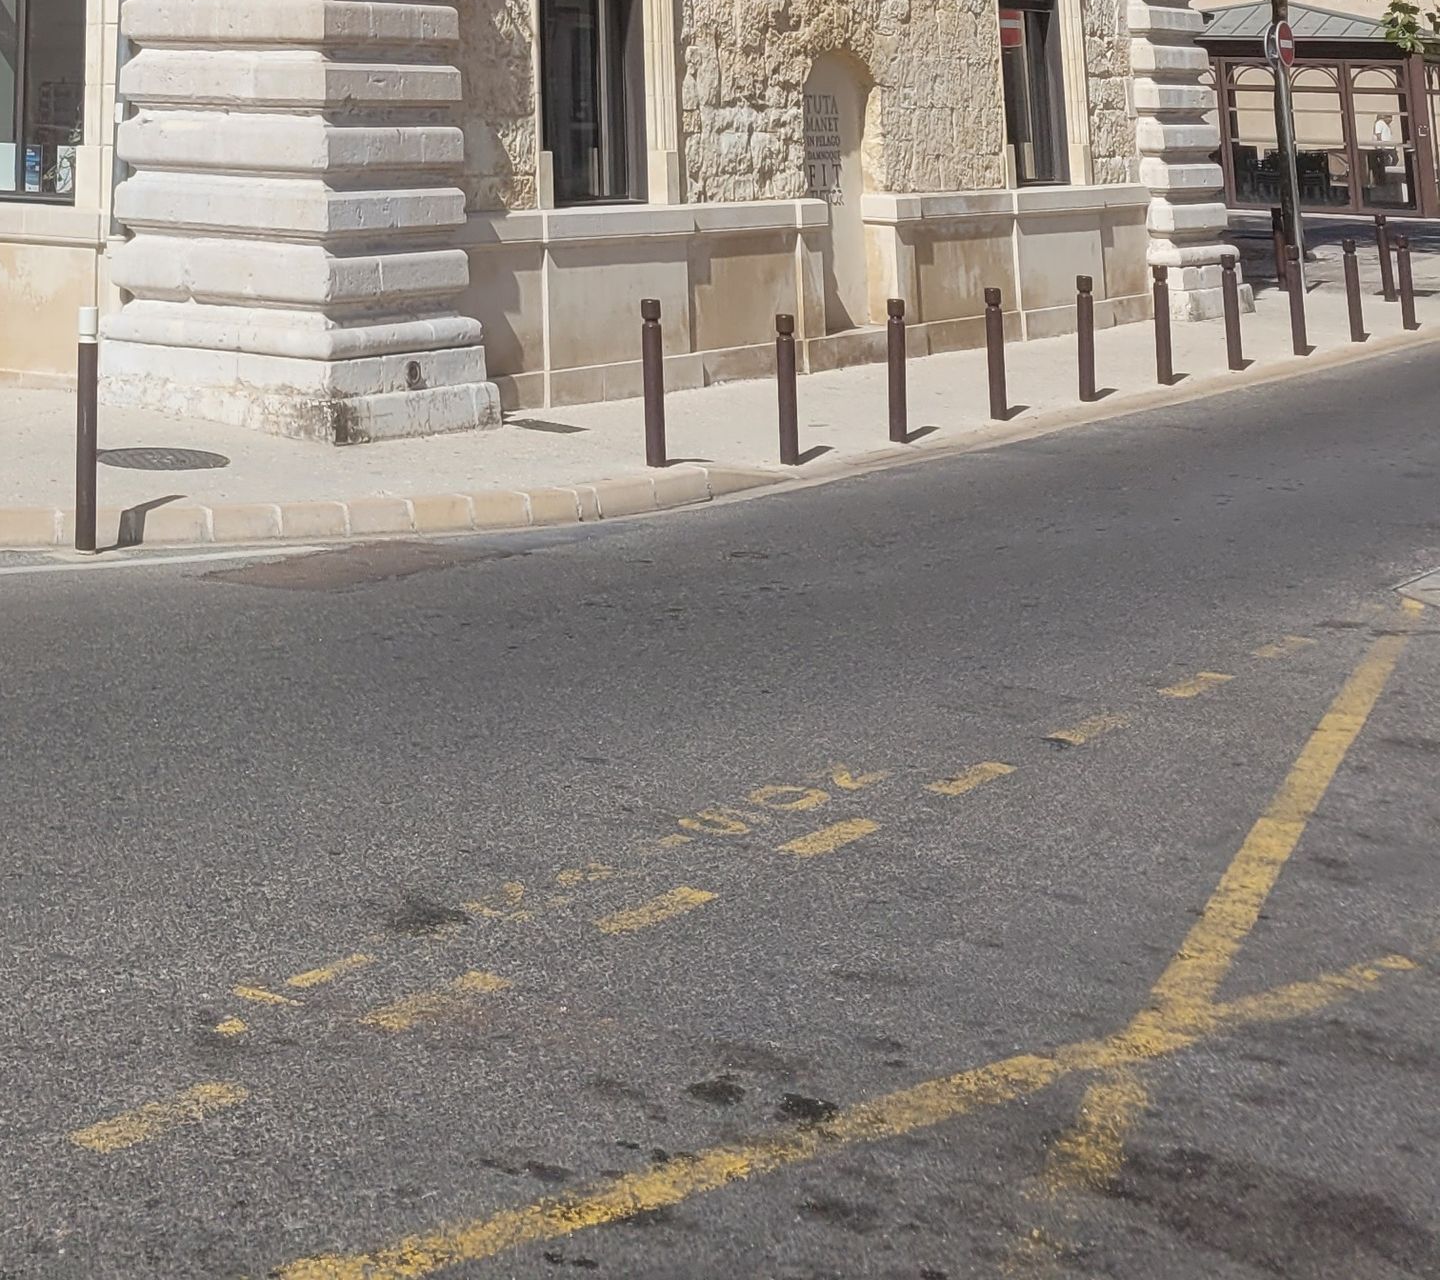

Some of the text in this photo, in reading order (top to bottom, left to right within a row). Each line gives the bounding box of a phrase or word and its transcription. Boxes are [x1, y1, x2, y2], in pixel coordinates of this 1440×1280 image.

[803, 94, 839, 115] TUTA
[805, 116, 839, 132] MANET
[808, 163, 843, 188] FIT
